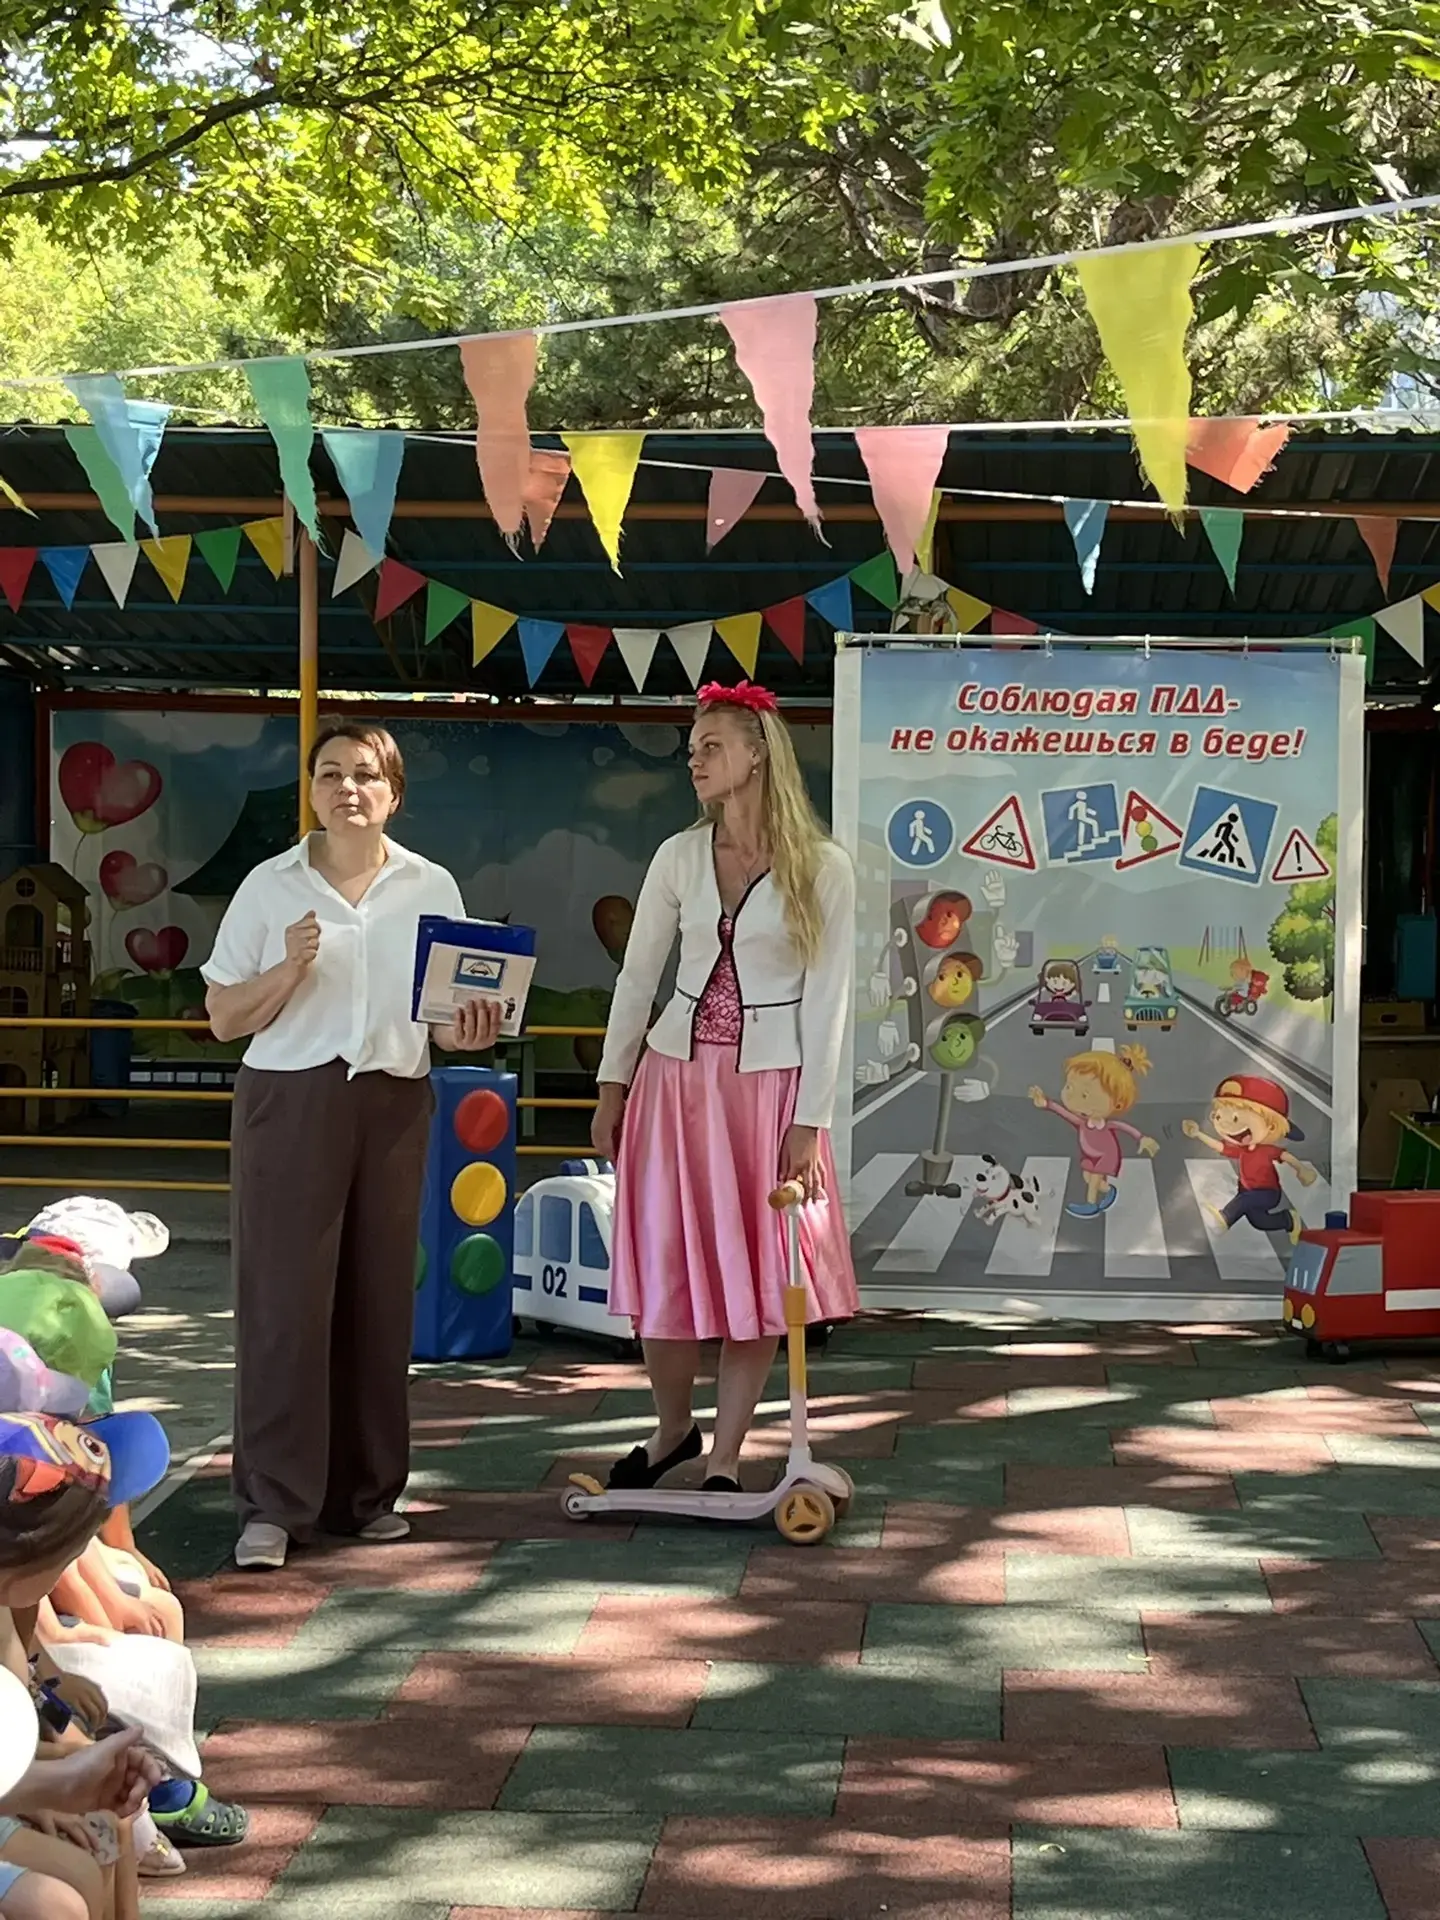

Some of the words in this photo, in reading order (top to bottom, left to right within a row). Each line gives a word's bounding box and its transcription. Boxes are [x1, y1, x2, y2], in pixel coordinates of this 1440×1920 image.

[957, 683, 1138, 719] Соблюдая
[890, 728, 935, 751] не
[947, 724, 1156, 754] окажешься
[1169, 732, 1189, 754] в
[1202, 727, 1305, 760] беде!
[542, 1264, 567, 1298] 02
